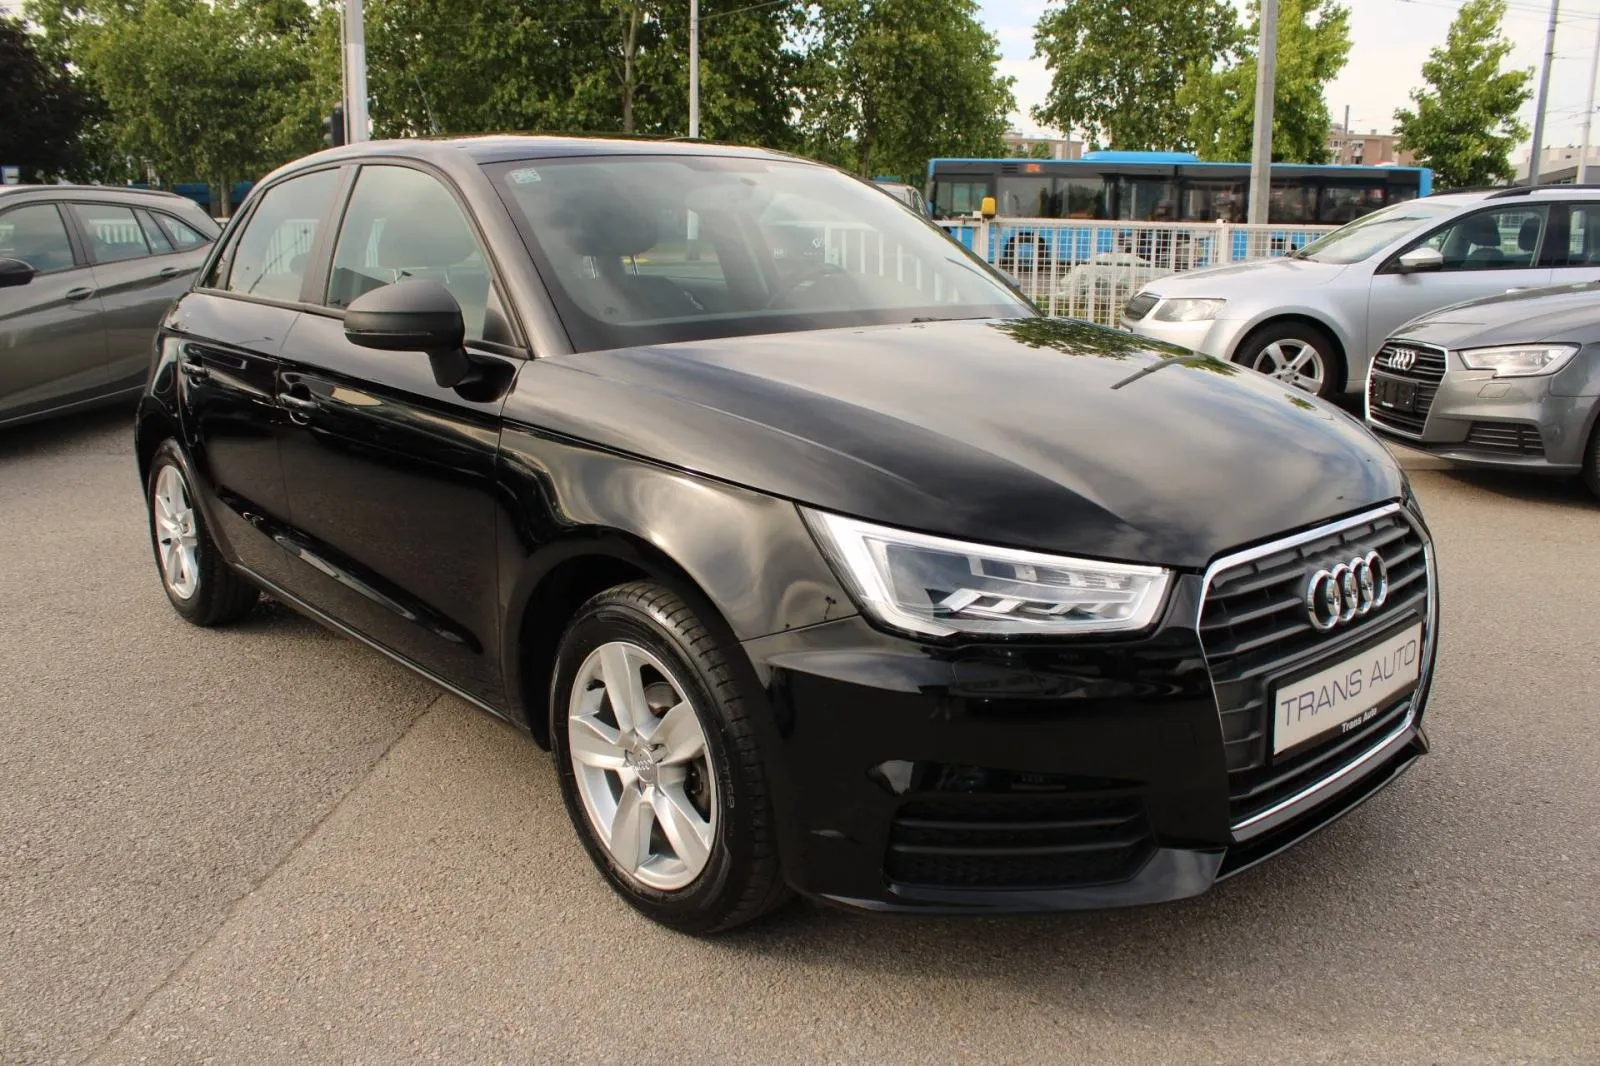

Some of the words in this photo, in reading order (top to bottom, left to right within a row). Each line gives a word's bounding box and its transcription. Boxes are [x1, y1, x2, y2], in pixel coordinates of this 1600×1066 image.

[1281, 669, 1362, 726] TRANS
[1369, 640, 1416, 687] AUTO
[1342, 715, 1362, 733] Trans
